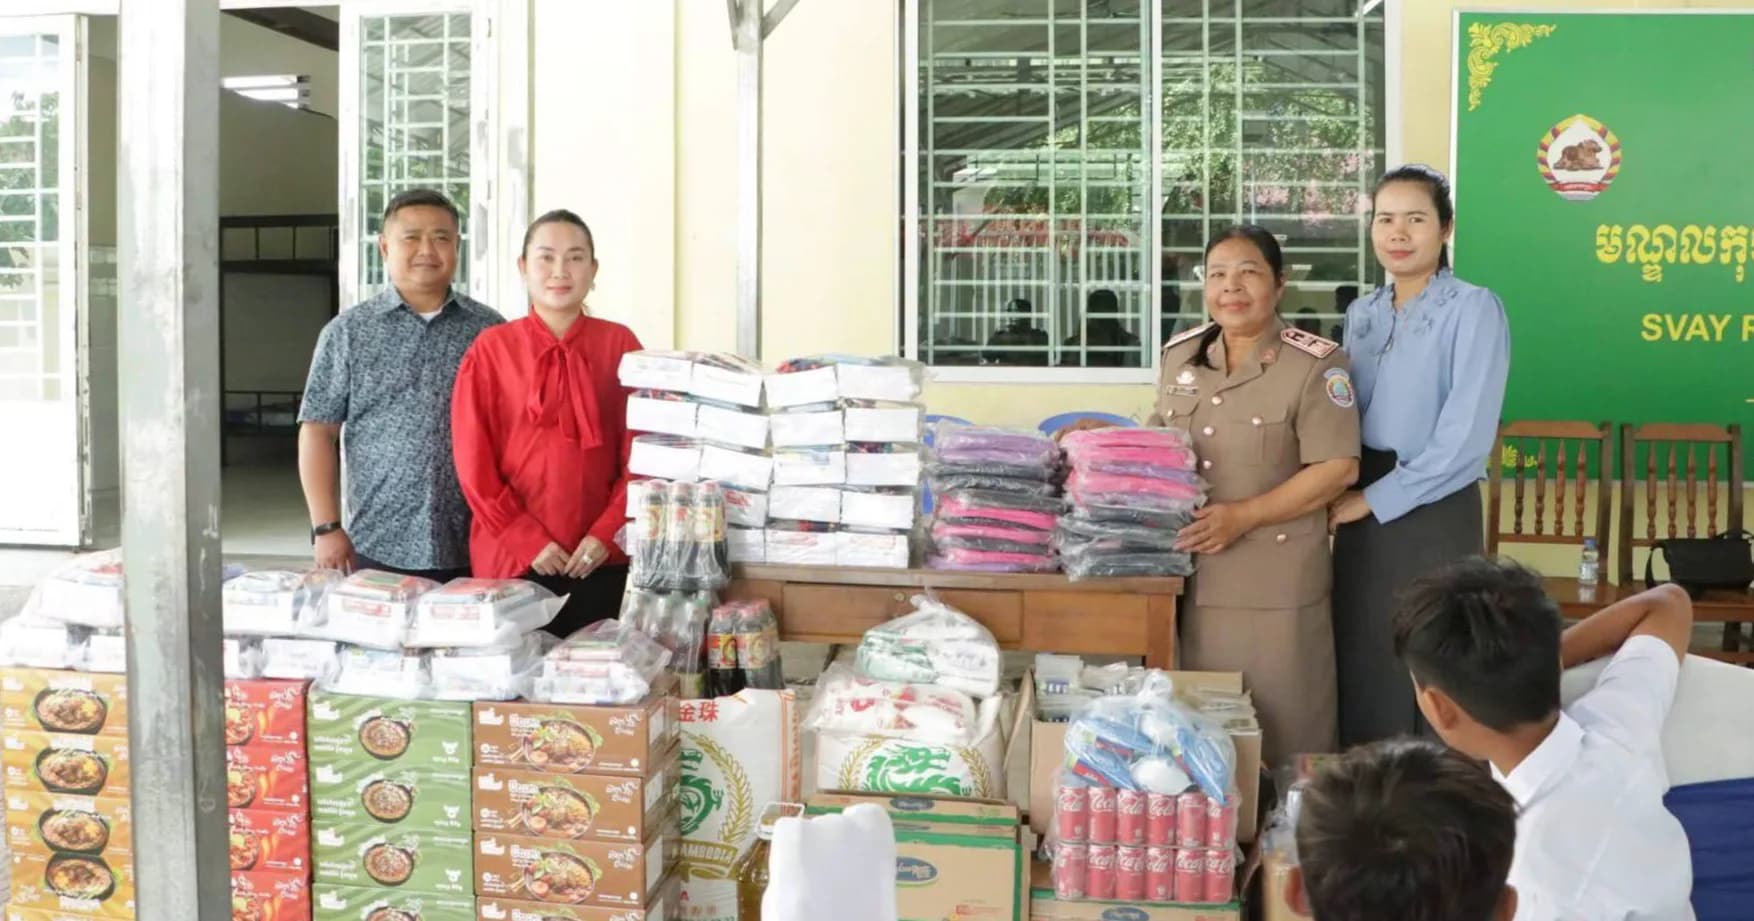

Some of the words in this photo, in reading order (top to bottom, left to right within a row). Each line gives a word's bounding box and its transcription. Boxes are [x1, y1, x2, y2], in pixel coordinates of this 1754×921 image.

[1595, 223, 1754, 283] មណ្ឌលកុ
[1640, 313, 1732, 342] SVAY
